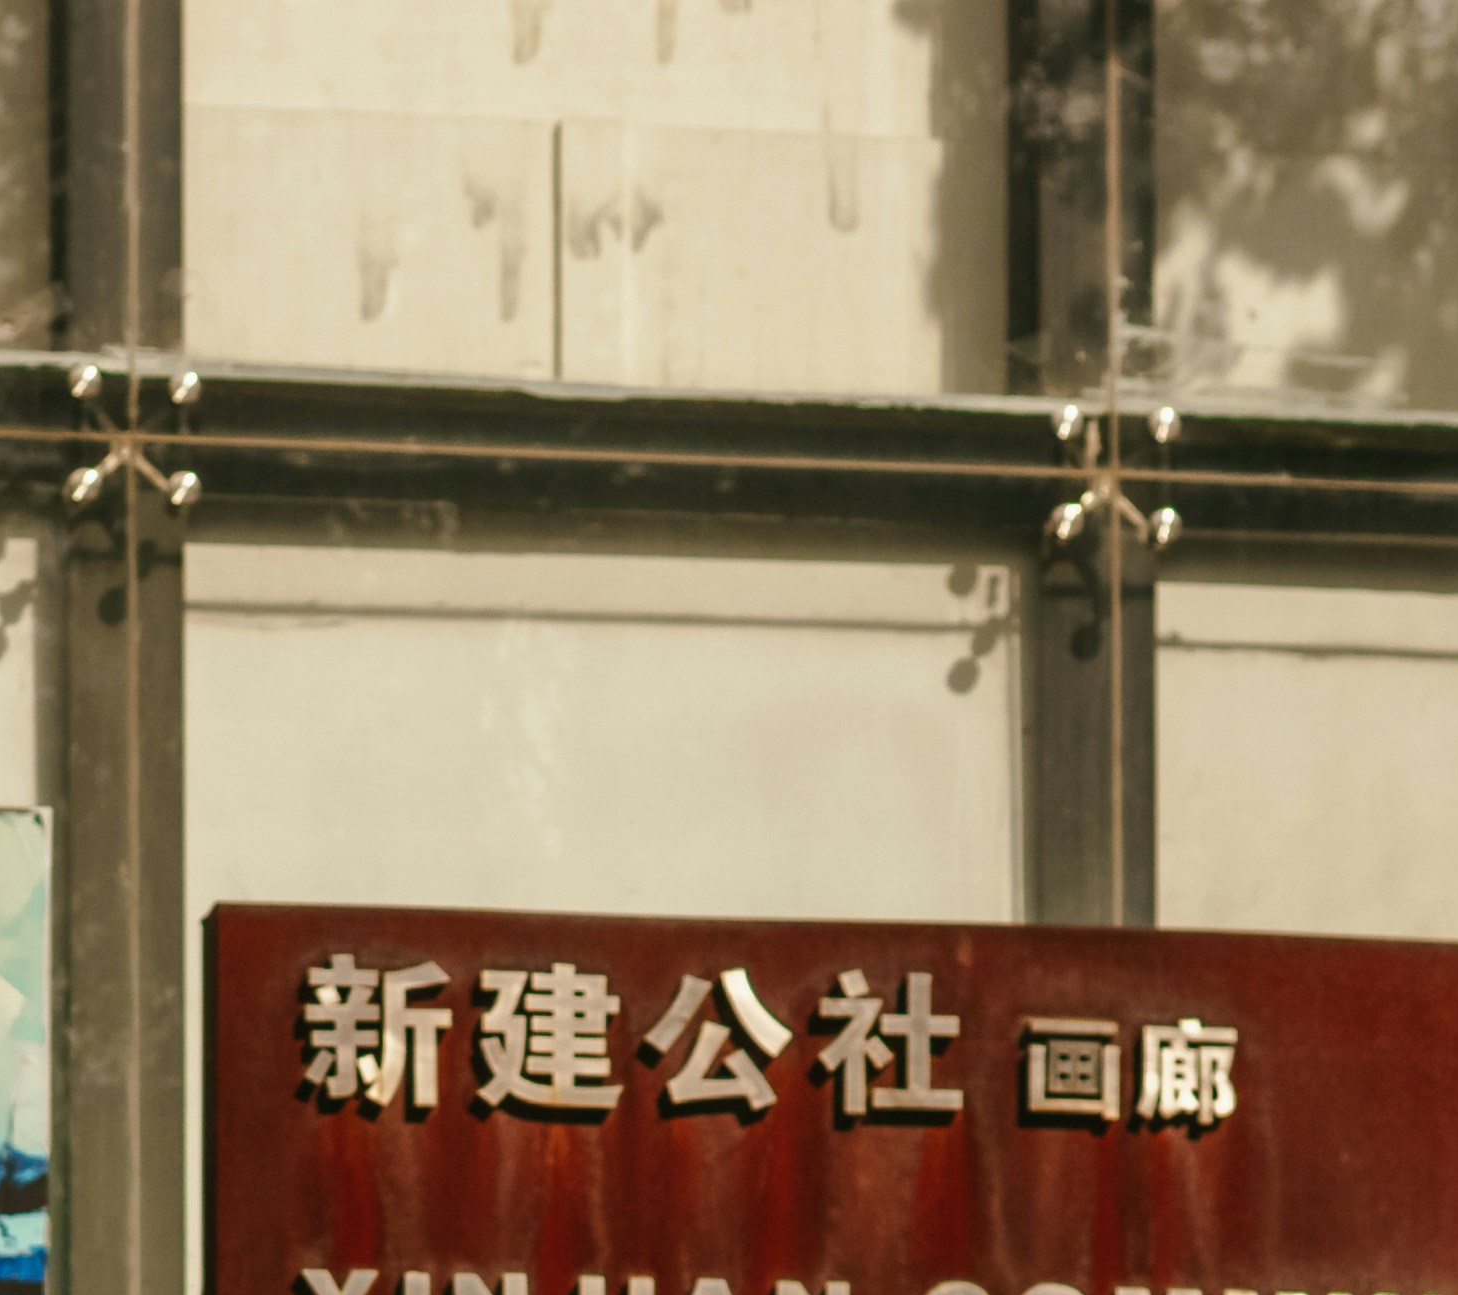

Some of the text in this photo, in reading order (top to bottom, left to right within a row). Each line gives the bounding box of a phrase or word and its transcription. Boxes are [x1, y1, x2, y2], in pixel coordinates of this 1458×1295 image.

[300, 953, 1241, 1128] 新建公社 画廊
